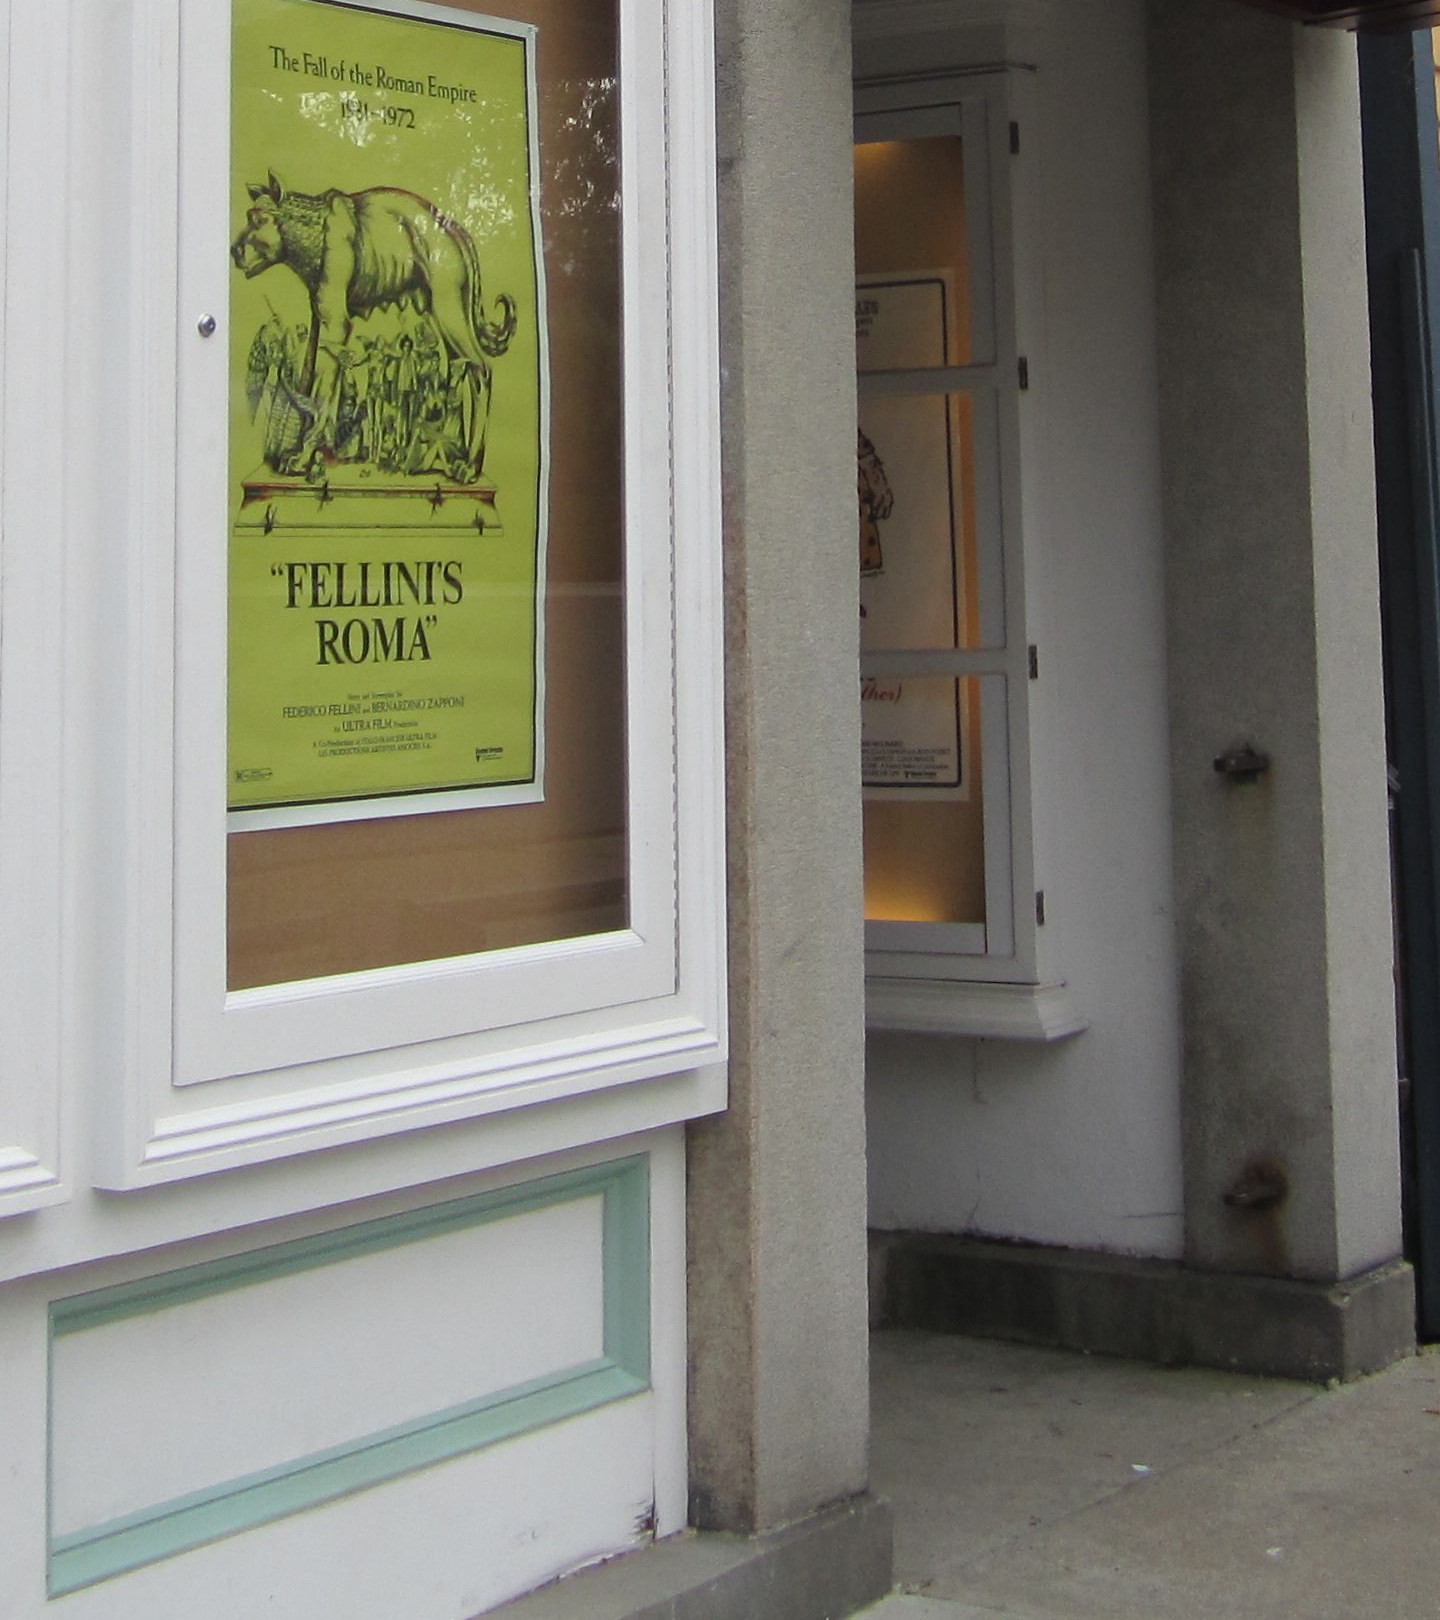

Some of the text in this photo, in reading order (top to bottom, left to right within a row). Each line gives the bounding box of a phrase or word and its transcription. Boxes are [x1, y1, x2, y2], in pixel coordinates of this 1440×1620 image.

[270, 46, 477, 105] The Fall of the Roman Empire
[315, 615, 438, 665] ROMA"
[283, 705, 327, 719] FEDERICO
[328, 703, 361, 717] FELLINI
[342, 719, 371, 732] ULTRA
[372, 718, 393, 730] FILM
